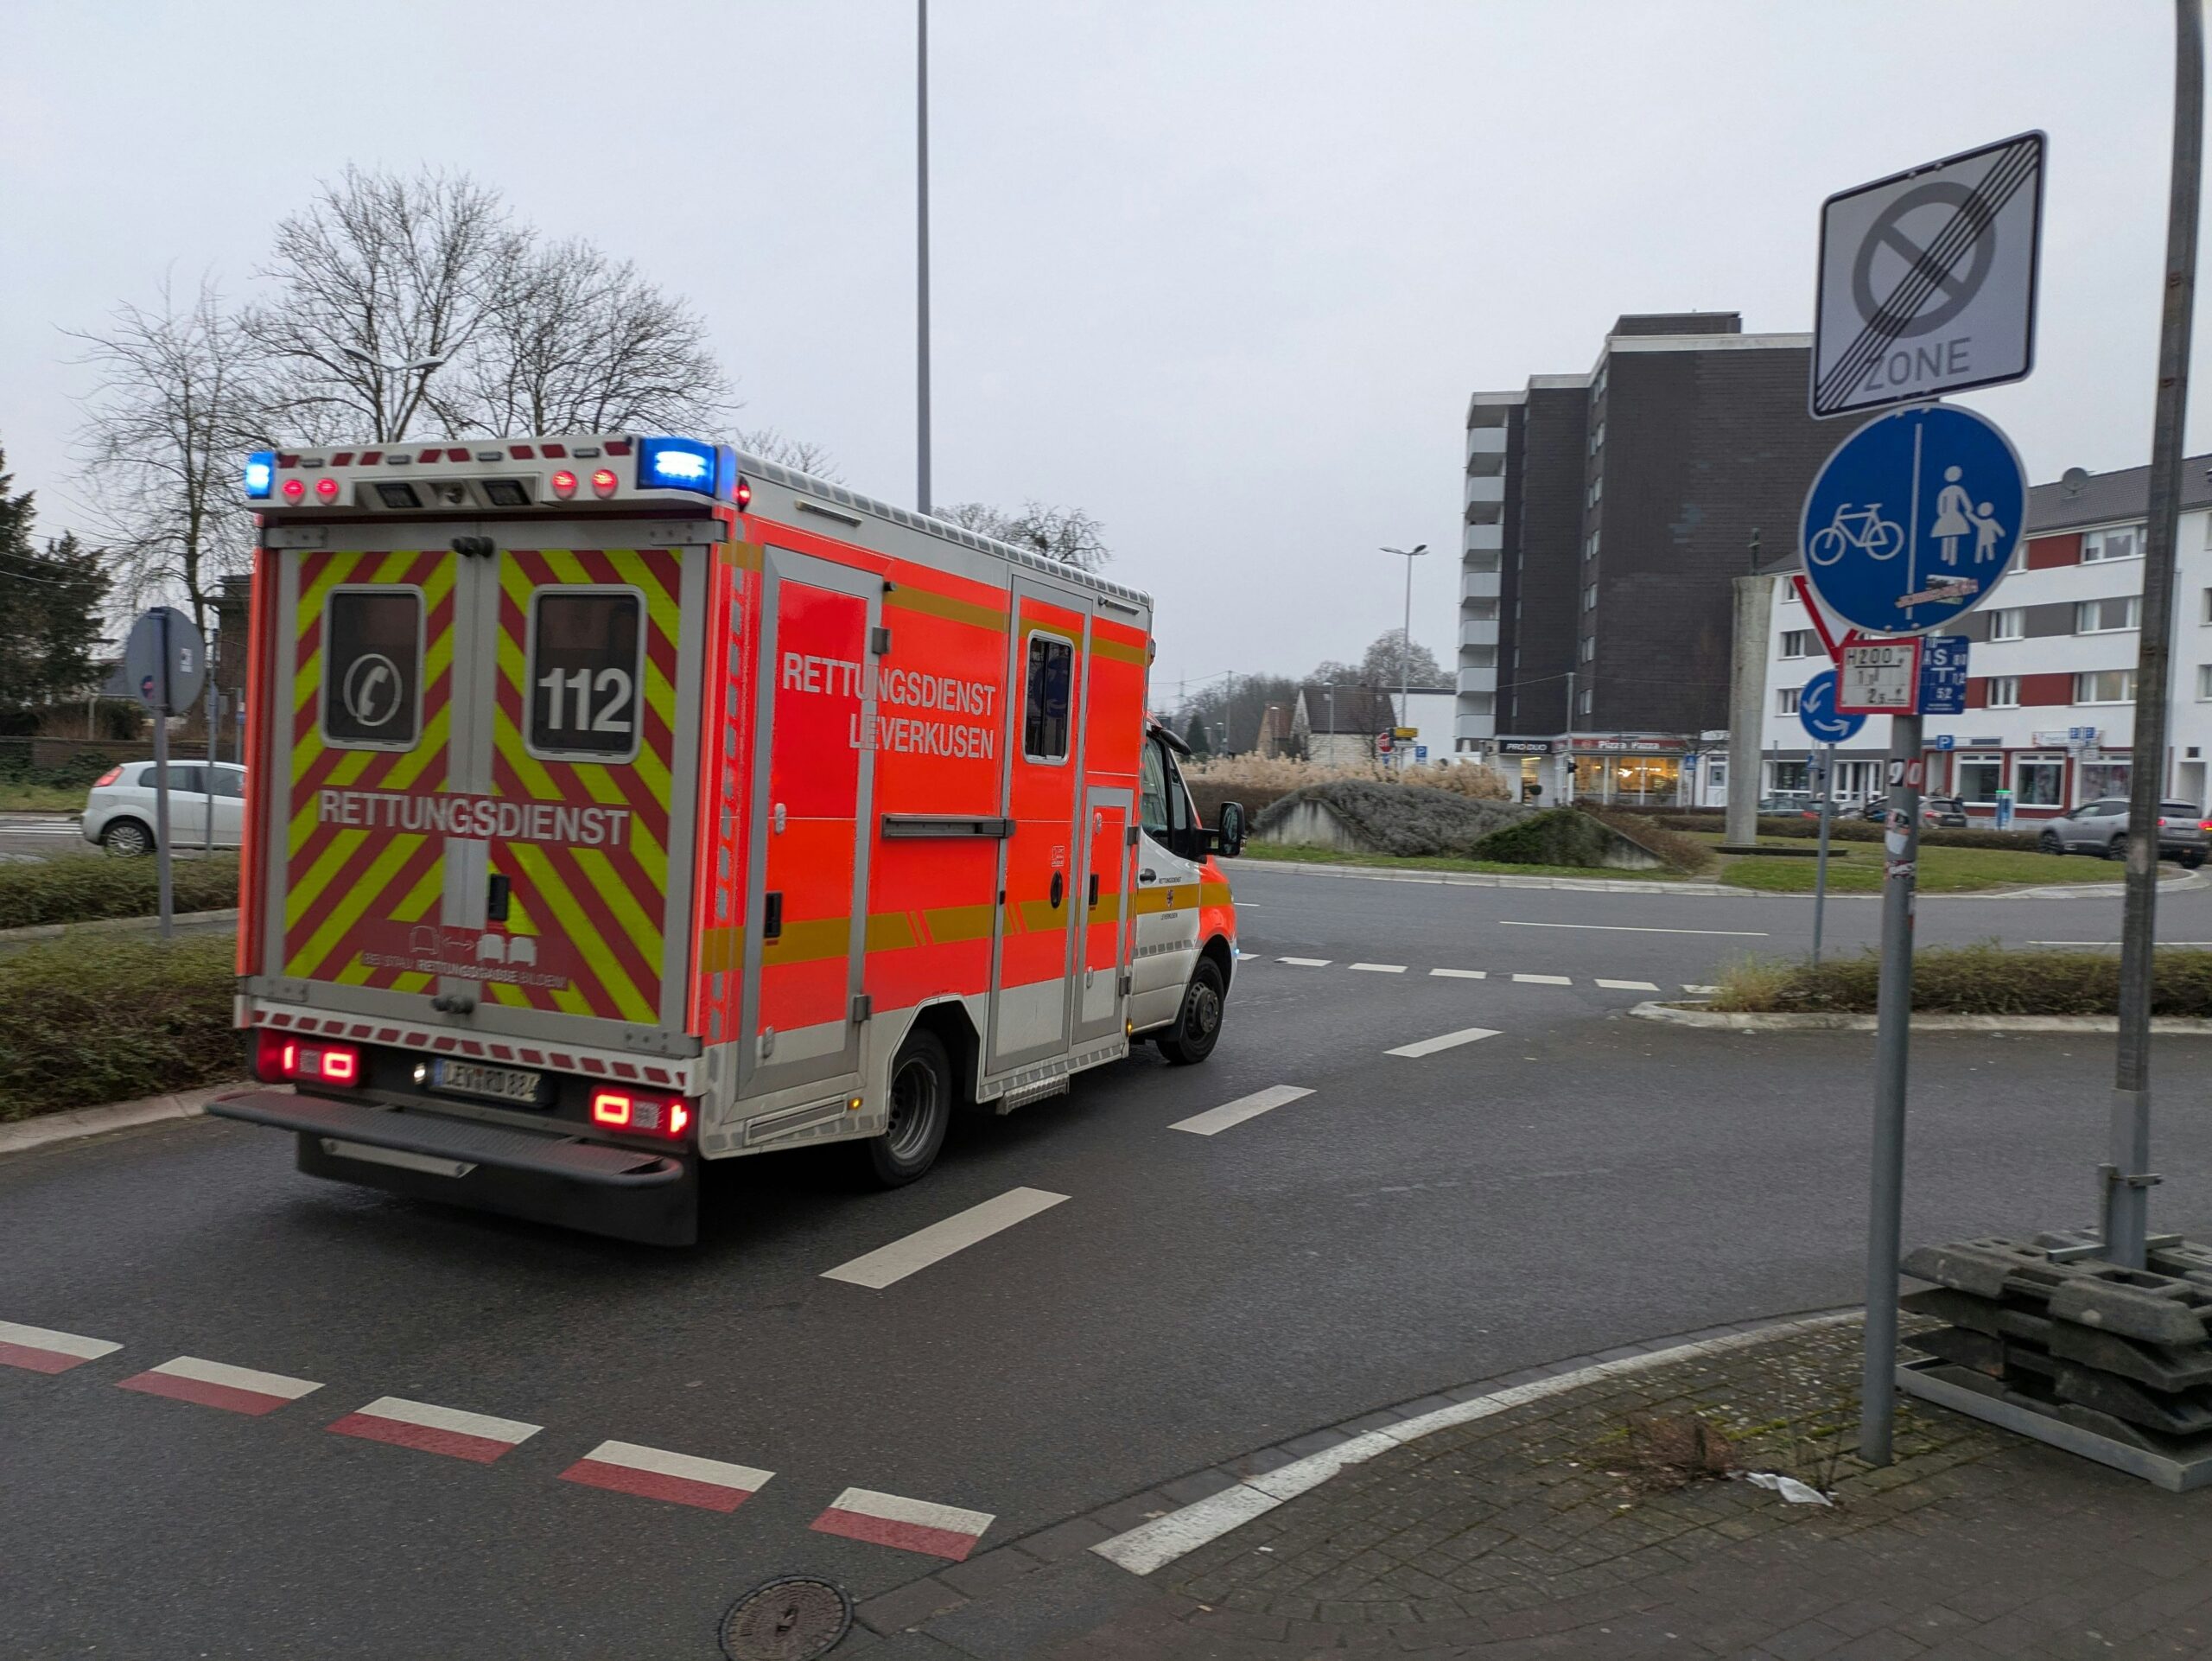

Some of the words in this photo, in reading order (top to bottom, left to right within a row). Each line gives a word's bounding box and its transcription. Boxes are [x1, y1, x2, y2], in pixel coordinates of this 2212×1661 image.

[1864, 337, 1972, 391] ZONE
[538, 668, 632, 733] 112
[783, 652, 996, 716] RETTUNGSDIENST
[849, 713, 994, 760] LEVERKUSEN
[320, 790, 629, 845] RETTUNGSDIENST
